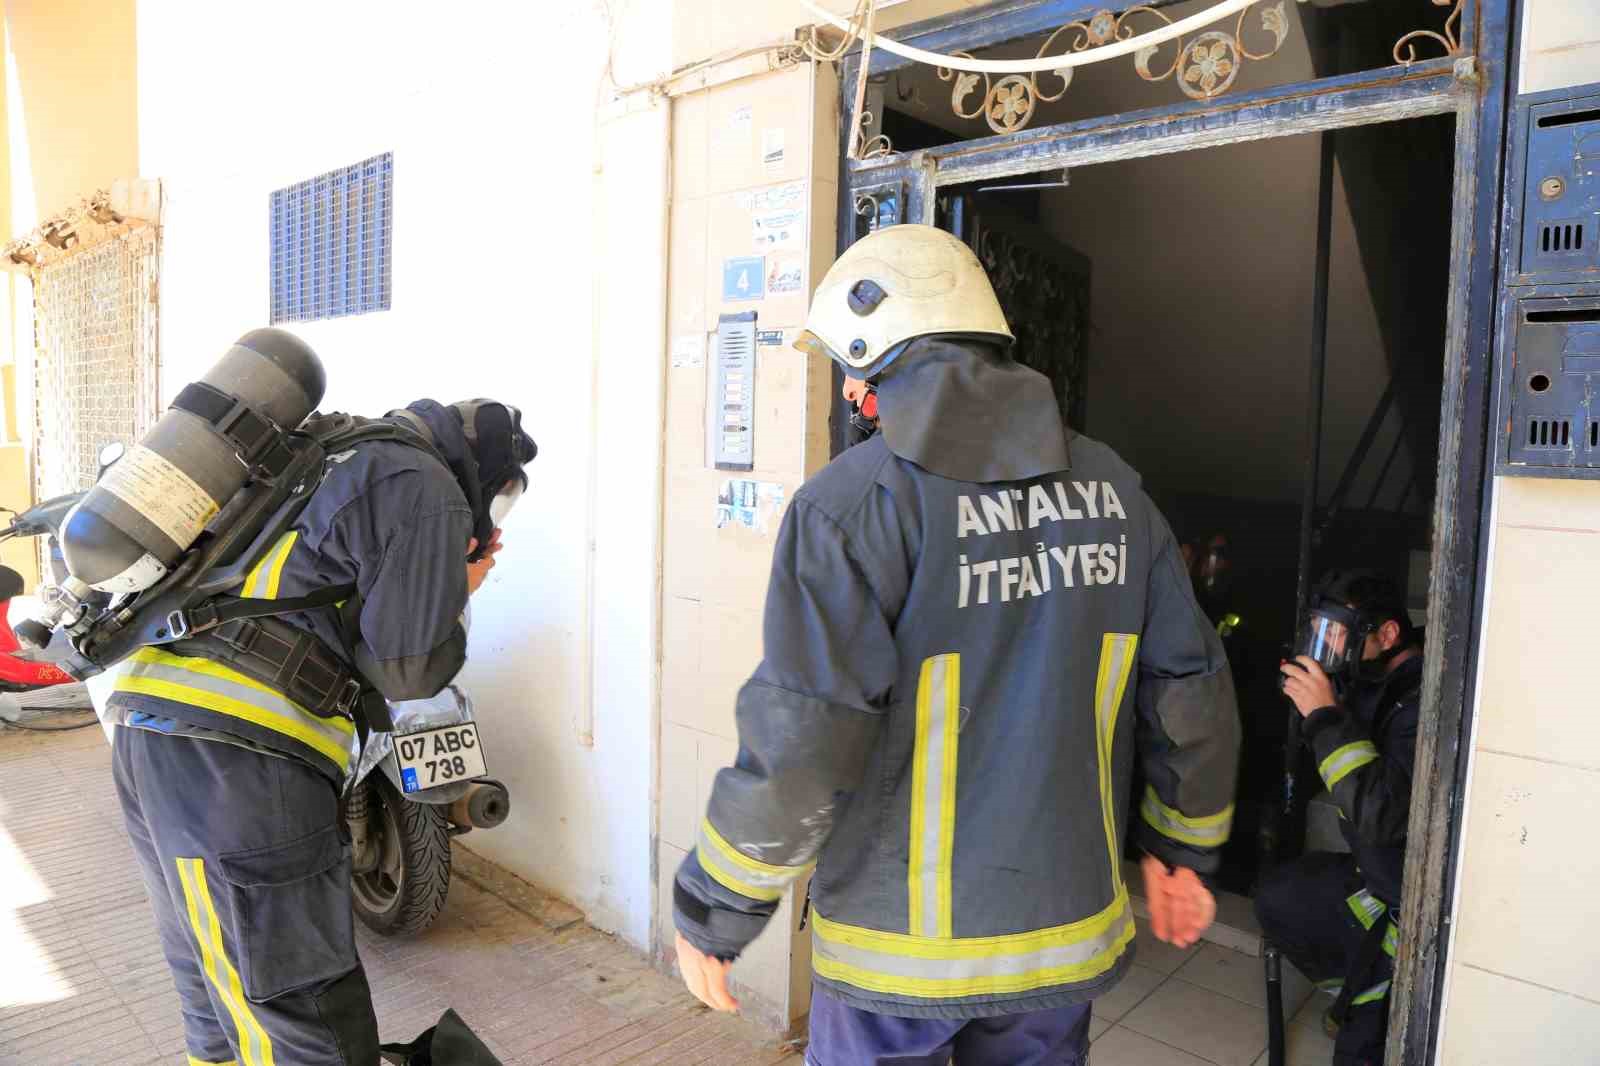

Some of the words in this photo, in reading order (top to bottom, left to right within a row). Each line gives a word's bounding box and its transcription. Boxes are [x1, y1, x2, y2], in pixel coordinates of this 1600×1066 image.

[736, 267, 752, 292] 4
[957, 480, 1127, 538] ANTALYA
[958, 534, 1127, 608] İTFAİYESİ
[400, 737, 425, 761] 07
[434, 729, 475, 755] ABC
[425, 756, 466, 783] 738
